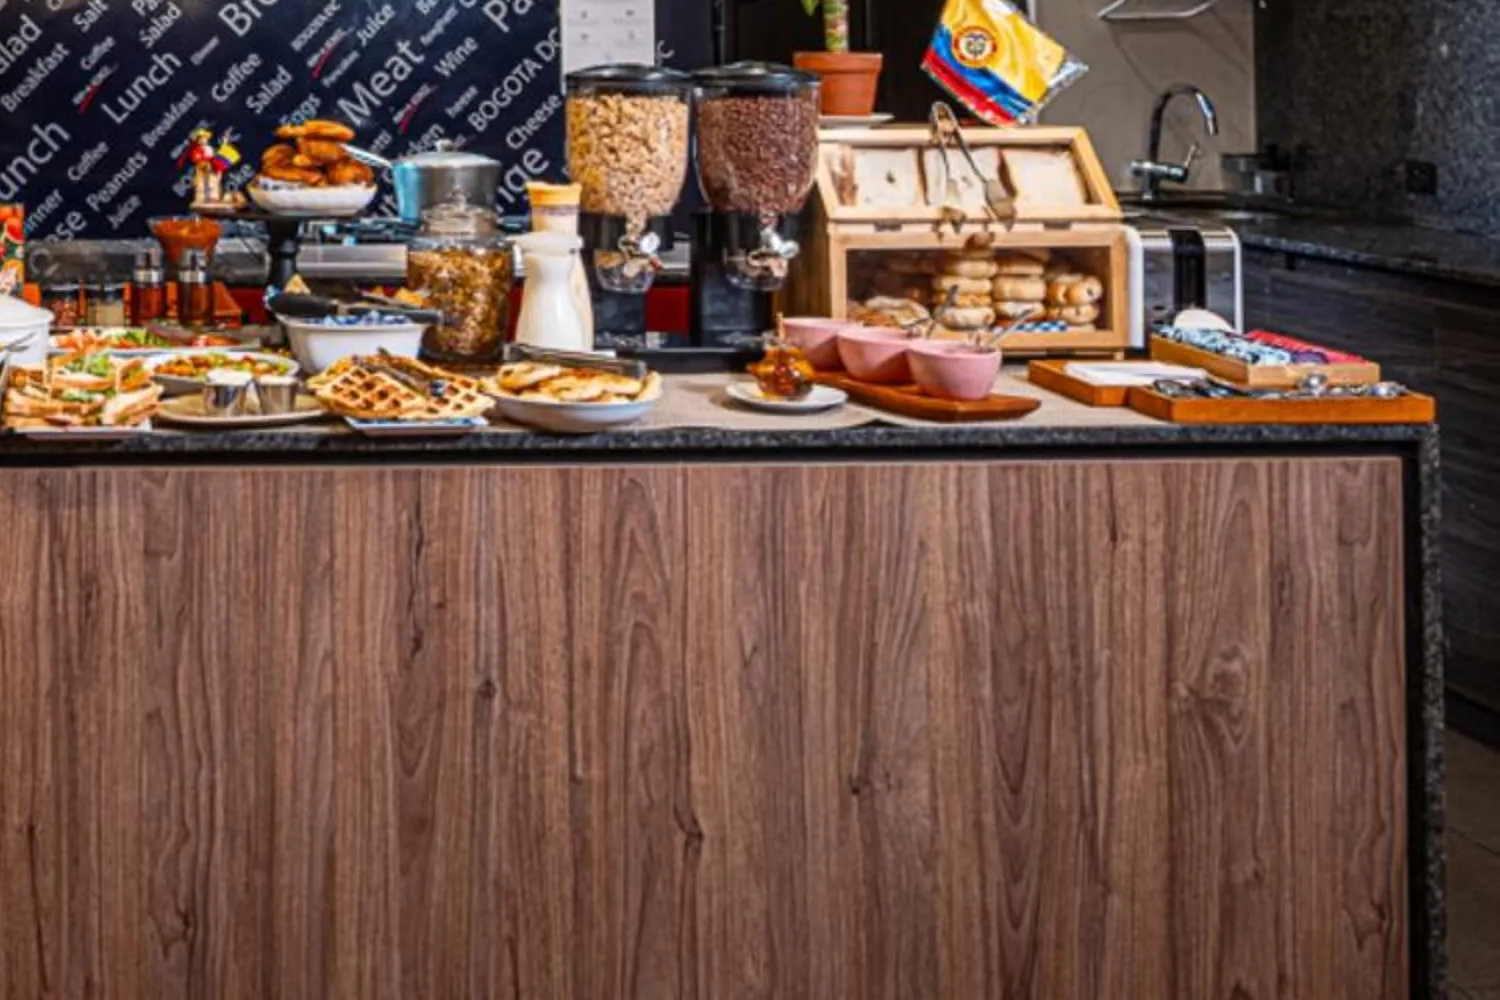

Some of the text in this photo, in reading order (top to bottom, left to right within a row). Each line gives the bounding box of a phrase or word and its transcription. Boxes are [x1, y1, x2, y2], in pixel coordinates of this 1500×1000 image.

[139, 1, 183, 49] Salad
[356, 3, 397, 47] Juice
[0, 42, 70, 113] Breakfast
[211, 52, 263, 103] Coffee
[336, 39, 426, 127] Meat
[433, 36, 479, 78] Wine
[100, 52, 183, 124] Lunch
[245, 63, 293, 115] Salad
[468, 57, 543, 132] BOGOTA
[141, 90, 198, 148] Breakfast
[505, 94, 562, 149] Cheese
[67, 141, 109, 181] Coffee
[86, 150, 148, 212] Peanuts
[106, 195, 142, 230] Juice
